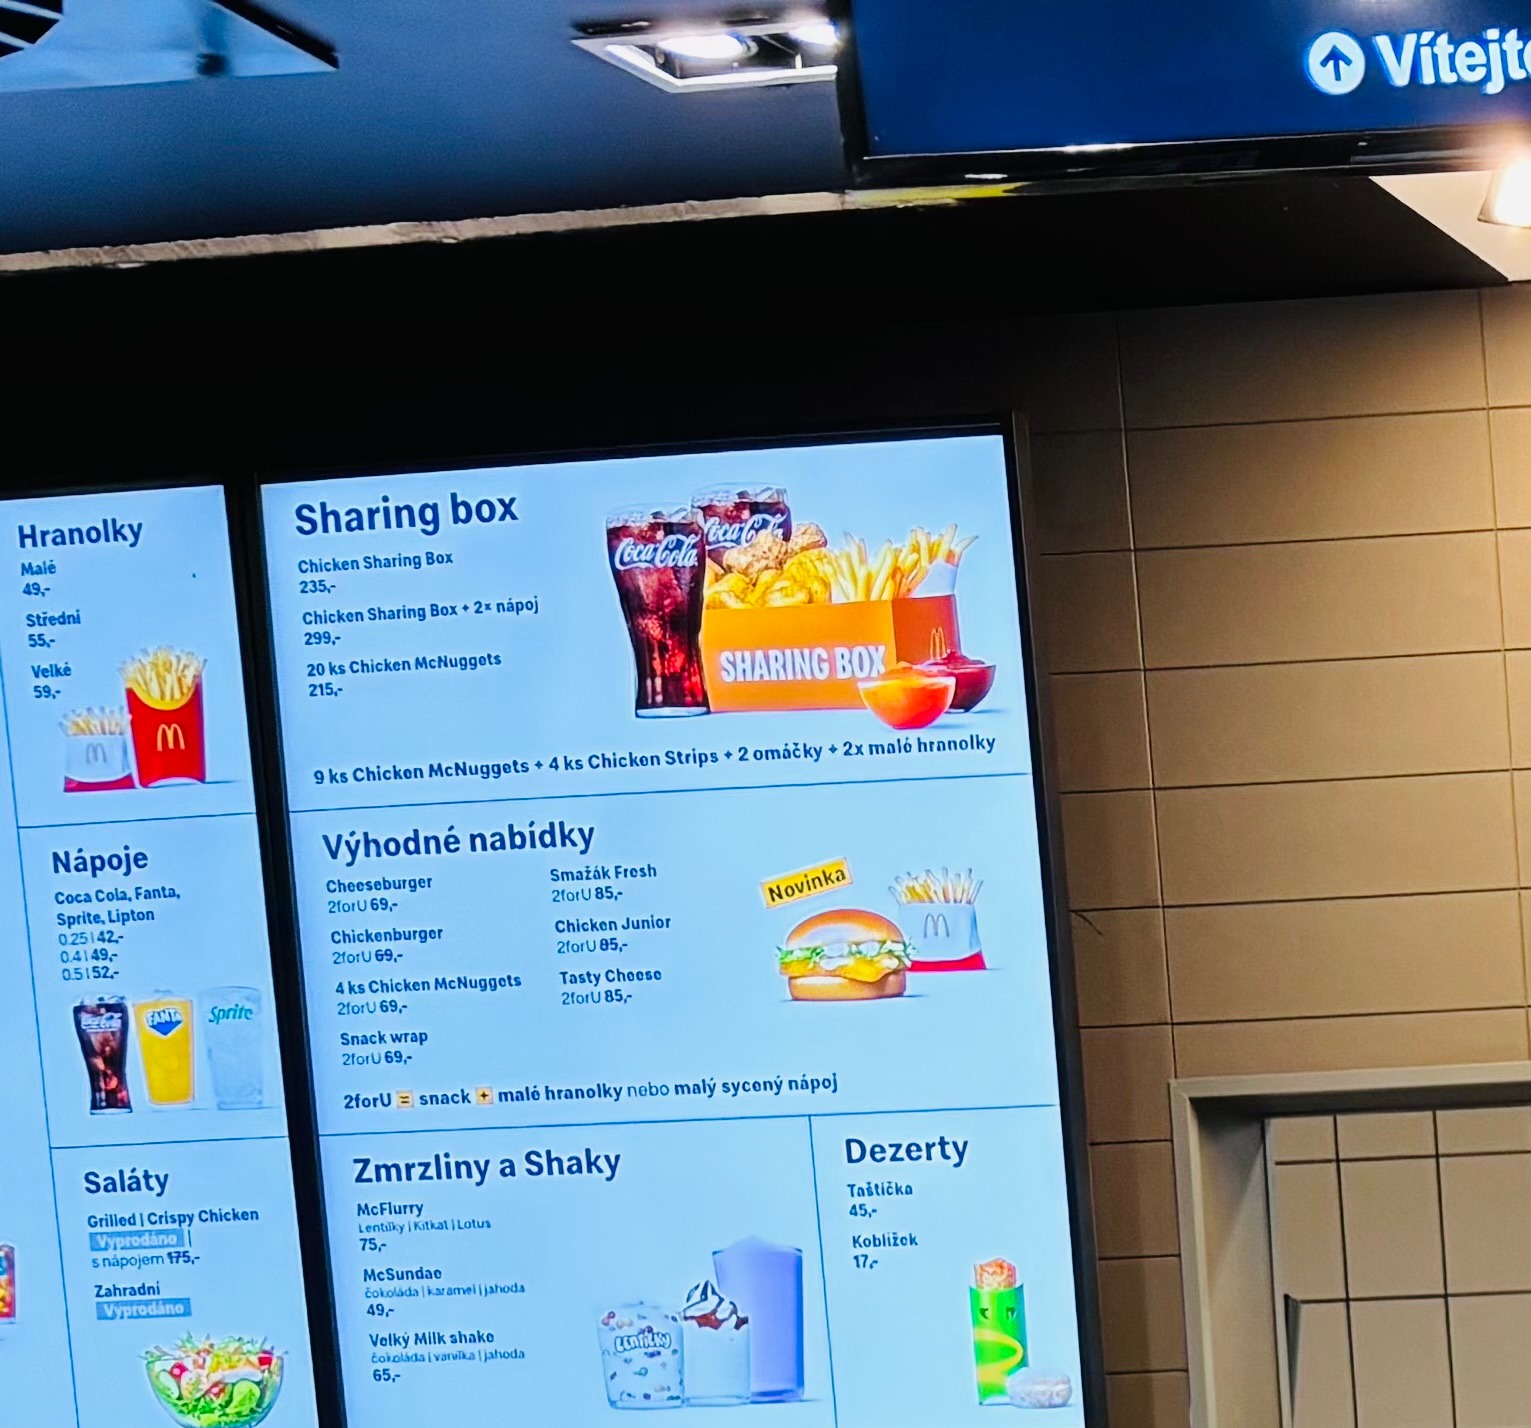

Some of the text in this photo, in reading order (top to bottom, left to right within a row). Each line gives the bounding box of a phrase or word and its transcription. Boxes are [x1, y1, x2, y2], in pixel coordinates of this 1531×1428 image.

[295, 493, 519, 535] Sharing box
[18, 518, 143, 548] Hranolky
[21, 560, 56, 576] Malé
[298, 551, 453, 574] Chicken Sharing Box
[22, 582, 50, 597] 49,-
[300, 581, 336, 594] 235,-
[26, 610, 81, 628] Střední
[303, 610, 364, 626] Chicken
[368, 607, 426, 622] Sharing
[430, 603, 457, 618] Box
[496, 596, 539, 617] nápoj
[28, 634, 55, 648] 55,-
[304, 632, 341, 646] 299,-
[32, 662, 72, 678] Velké
[307, 654, 502, 677] 20 ks Chicken McNuggets
[720, 646, 886, 682] SHARING BOX
[34, 686, 61, 700] 59,-
[309, 683, 342, 697] 215,-
[314, 735, 996, 784] 9 ks Chicken McNuggets 4 ks Strips 2 omáčky 2x hranolky
[322, 821, 595, 867] Výhodné nabídky
[52, 845, 148, 878] Nápoje
[550, 864, 657, 882] Smažák Fresh
[326, 876, 432, 893] Cheeseburger
[766, 867, 847, 903] Novinka
[55, 885, 180, 905] Coca Cola, Fanta,
[552, 887, 623, 903] 2forU 85,-
[328, 898, 398, 914] 2forU 69,-
[57, 909, 155, 928] Sprite, Lipton
[621, 914, 671, 931] Junior
[331, 927, 444, 945] Chickenburger
[600, 938, 628, 953] 85,-
[375, 949, 403, 964] 69,-
[348, 974, 522, 995] ks McNuggets
[559, 968, 662, 987] Tasty Cheese
[604, 989, 633, 1005] 85,-
[208, 1003, 253, 1024] Sprite
[380, 1000, 408, 1015] 69,-
[340, 1031, 429, 1047] Snack wrap
[419, 1073, 838, 1107] snack malé hranolky nebo malý sycený nápoj
[845, 1135, 969, 1168] Dezerty
[353, 1148, 621, 1186] Zmrzliny a Shaky
[84, 1167, 169, 1197] Saláty
[357, 1202, 424, 1218] McFlurry
[849, 1204, 878, 1219] 45,-
[87, 1211, 194, 1228] Grilled Crispy
[96, 1233, 177, 1251] Vyprodáno
[360, 1238, 386, 1253] 75,-
[92, 1254, 165, 1270] s nápojem
[853, 1255, 879, 1270] 17,-
[363, 1267, 442, 1282] McSundae
[94, 1281, 160, 1298] Zahradní
[367, 1303, 395, 1318] 49,-
[369, 1332, 447, 1348] Velký Milk
[373, 1369, 401, 1383] 65,-
